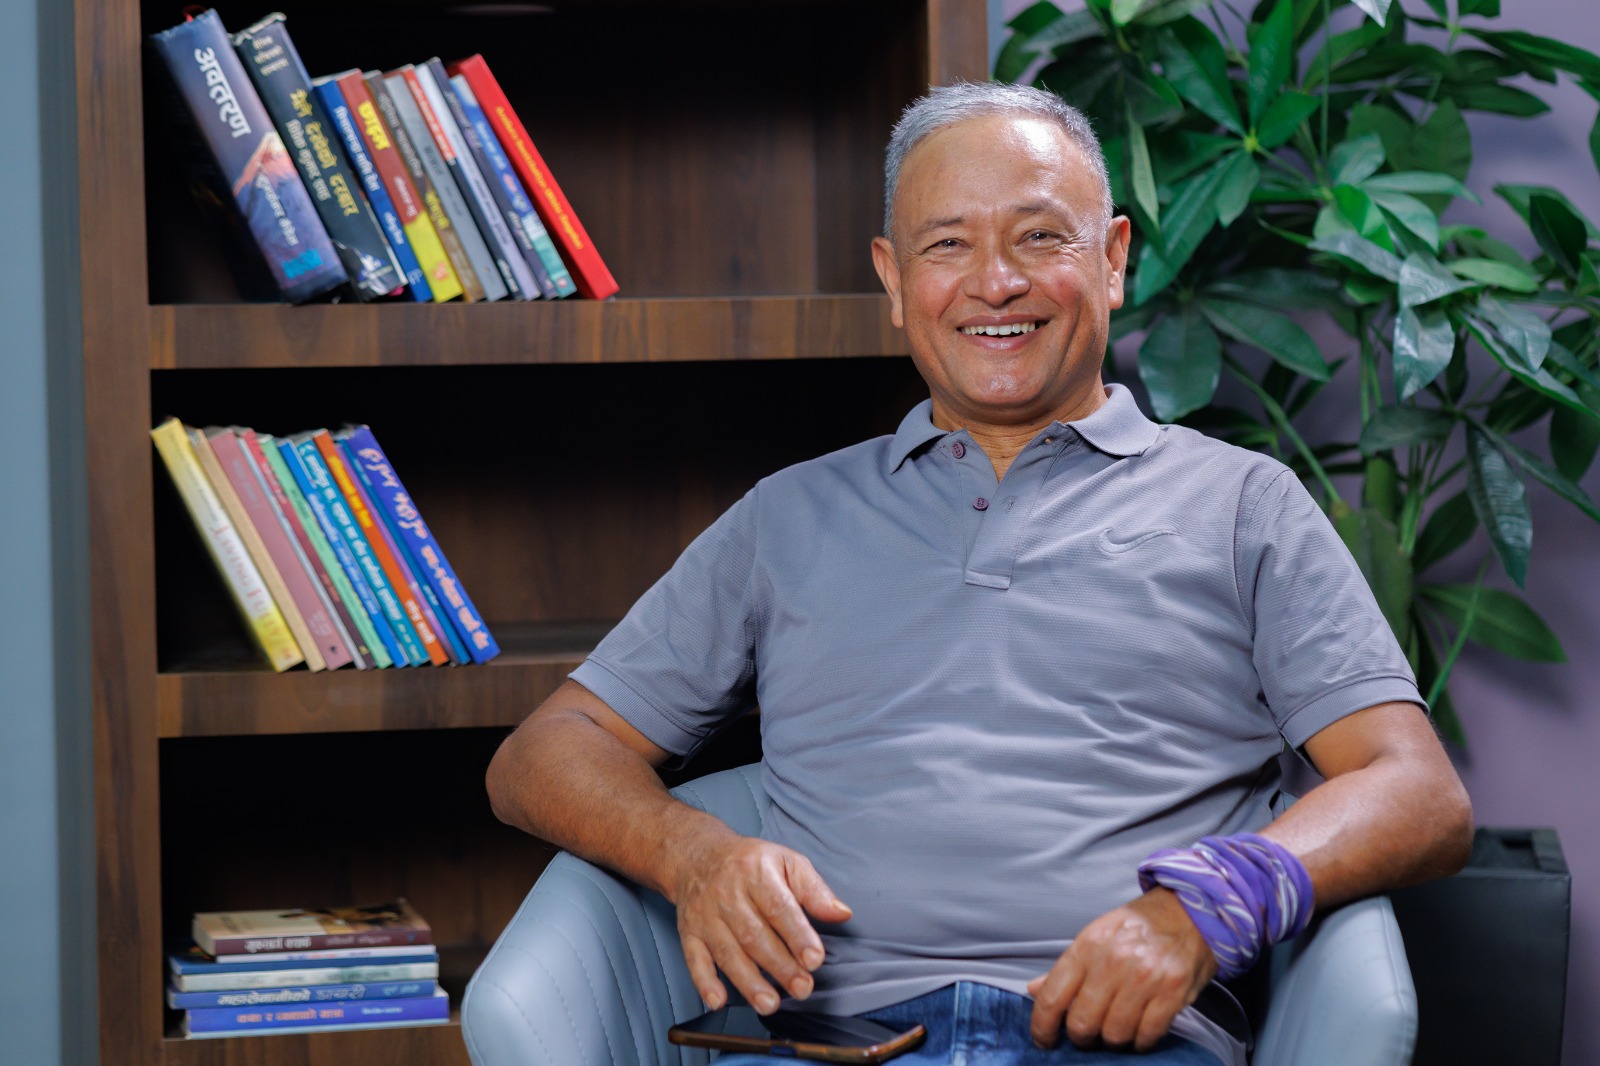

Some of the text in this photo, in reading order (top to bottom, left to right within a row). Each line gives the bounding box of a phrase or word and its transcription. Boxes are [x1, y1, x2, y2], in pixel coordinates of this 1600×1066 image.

[193, 46, 252, 140] अवतरण
[303, 121, 339, 169] देखेको
[328, 173, 358, 217] दरबार
